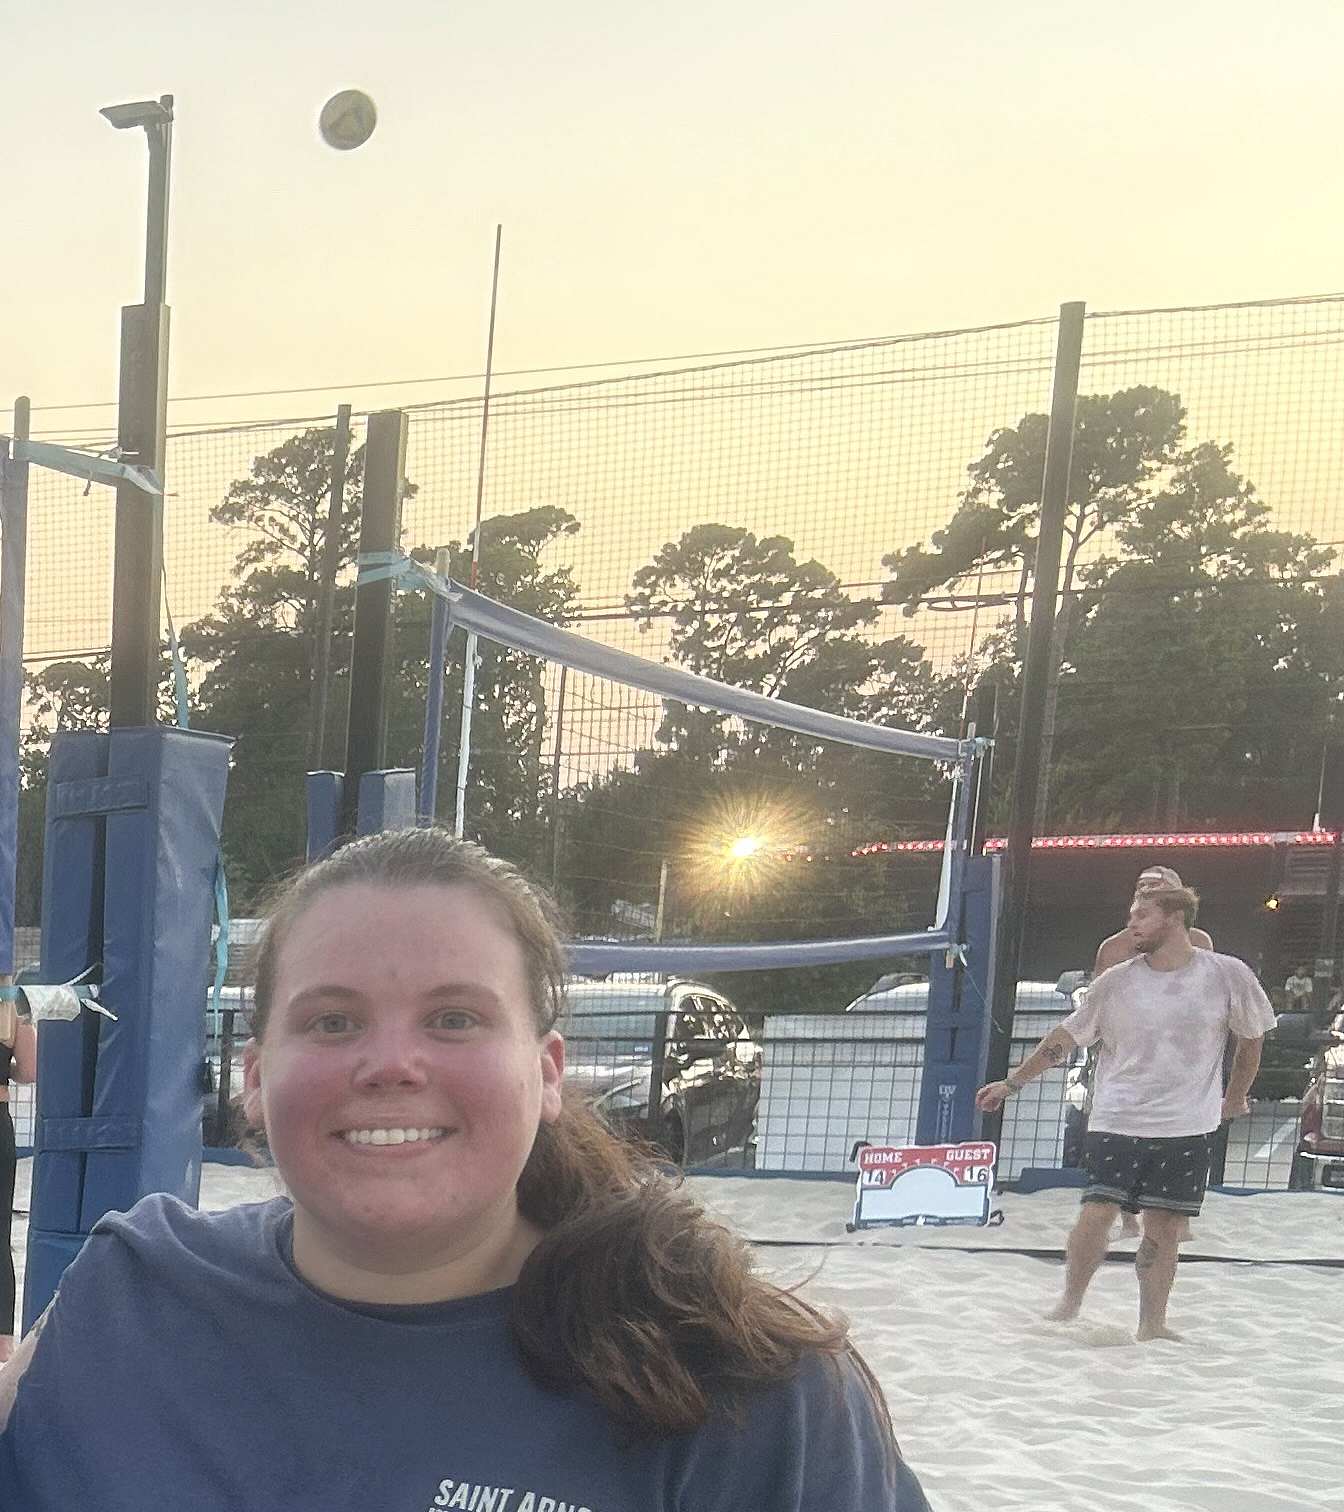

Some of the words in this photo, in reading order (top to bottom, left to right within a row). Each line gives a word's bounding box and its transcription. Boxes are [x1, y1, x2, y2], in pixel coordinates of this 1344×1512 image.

[864, 1151, 903, 1164] HOME
[946, 1149, 991, 1161] GUEST
[867, 1169, 885, 1185] 14
[967, 1166, 989, 1183] 16
